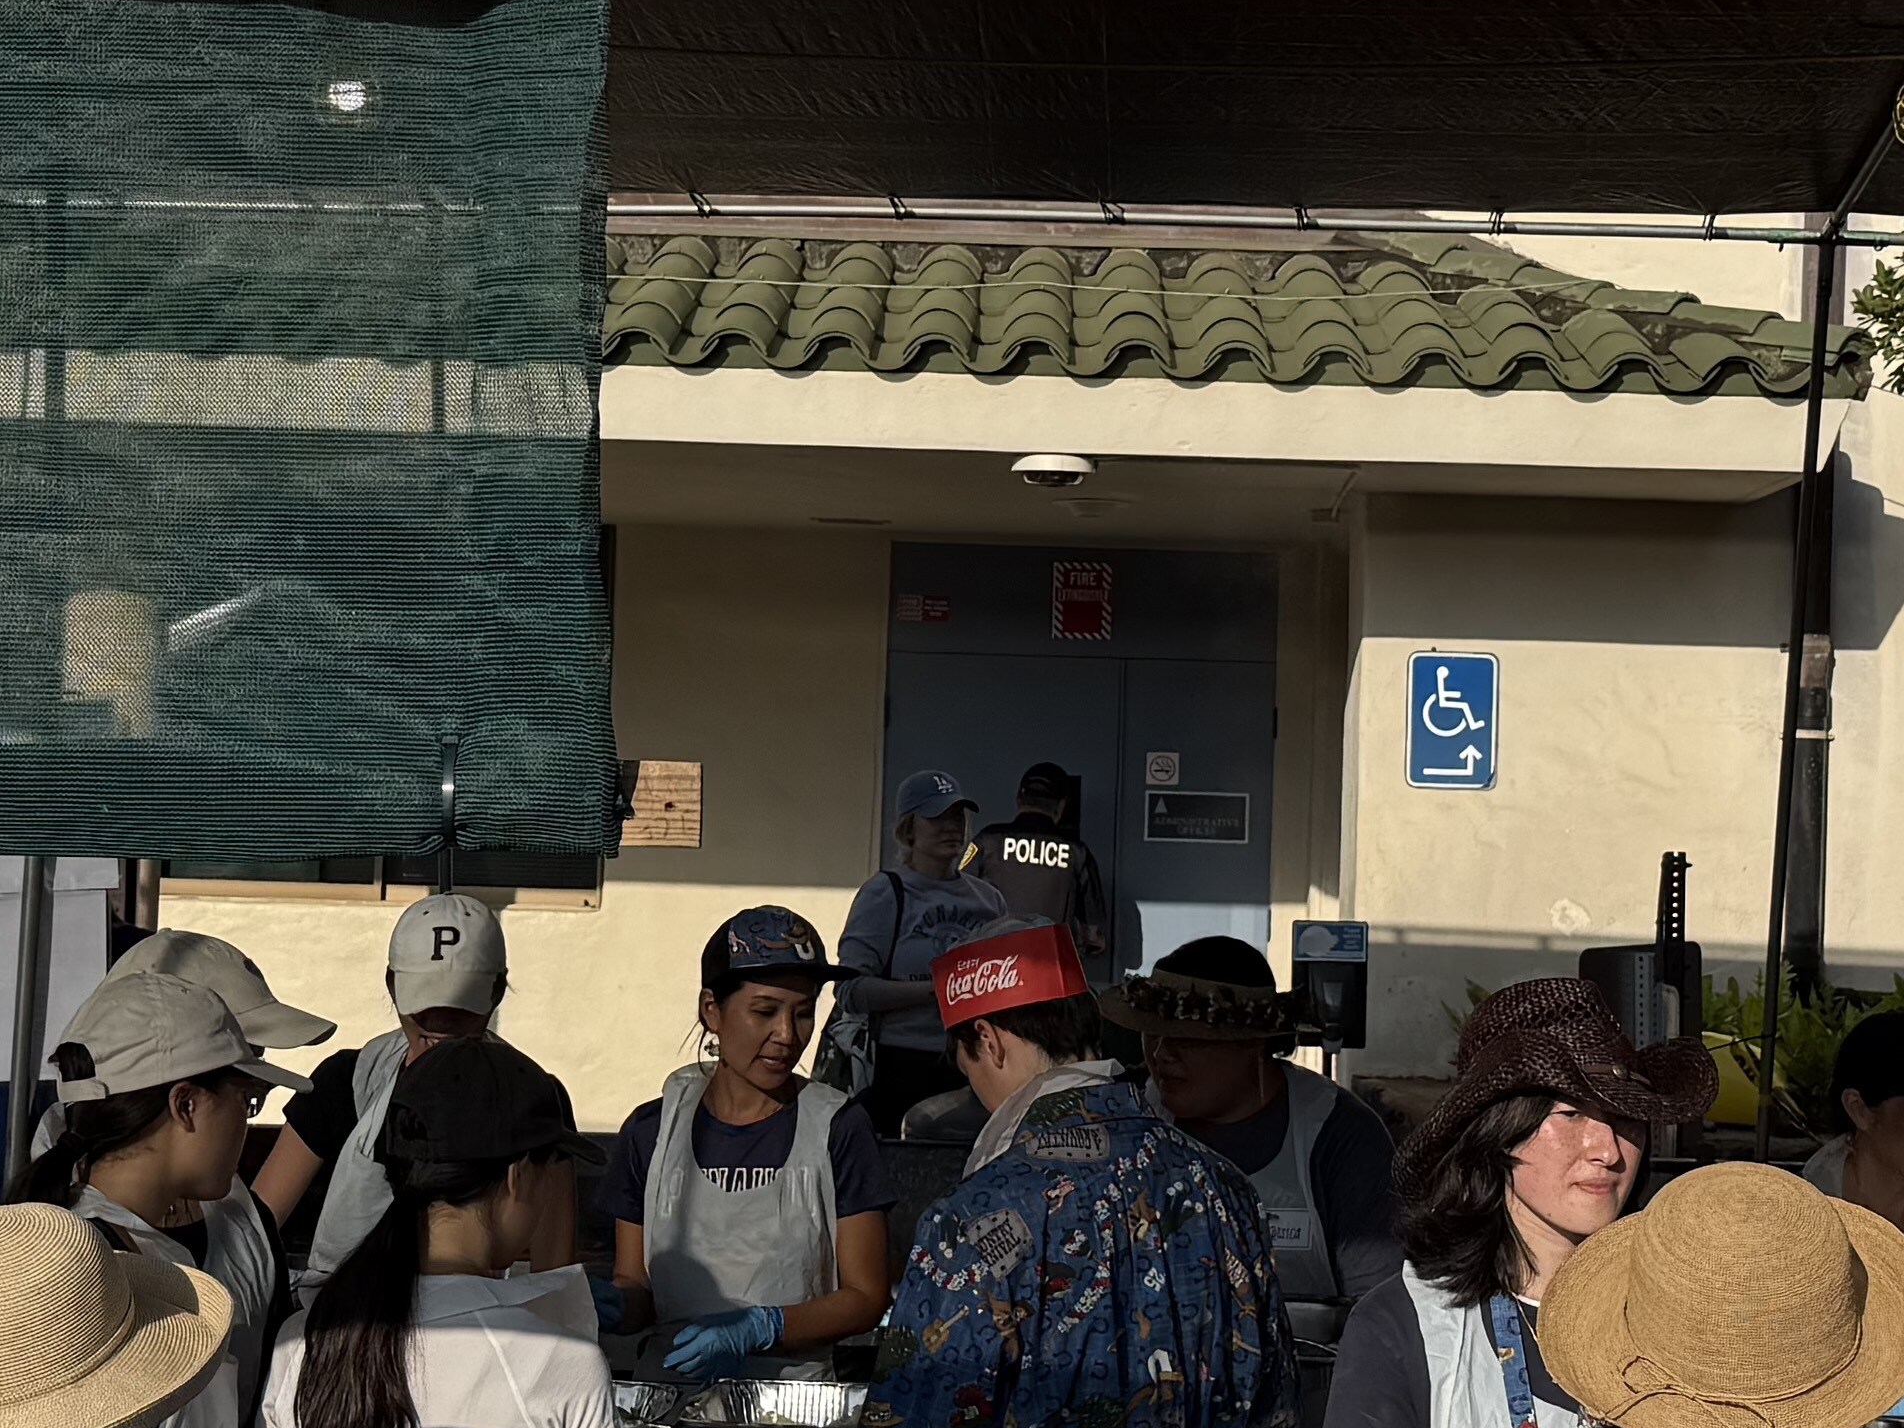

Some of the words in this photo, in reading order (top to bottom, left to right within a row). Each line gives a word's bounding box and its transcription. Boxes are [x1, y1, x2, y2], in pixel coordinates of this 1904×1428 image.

[1069, 572, 1098, 586] FIRE
[1002, 837, 1071, 869] POLICE
[431, 925, 461, 961] P
[945, 953, 1021, 1007] Coca-Cola
